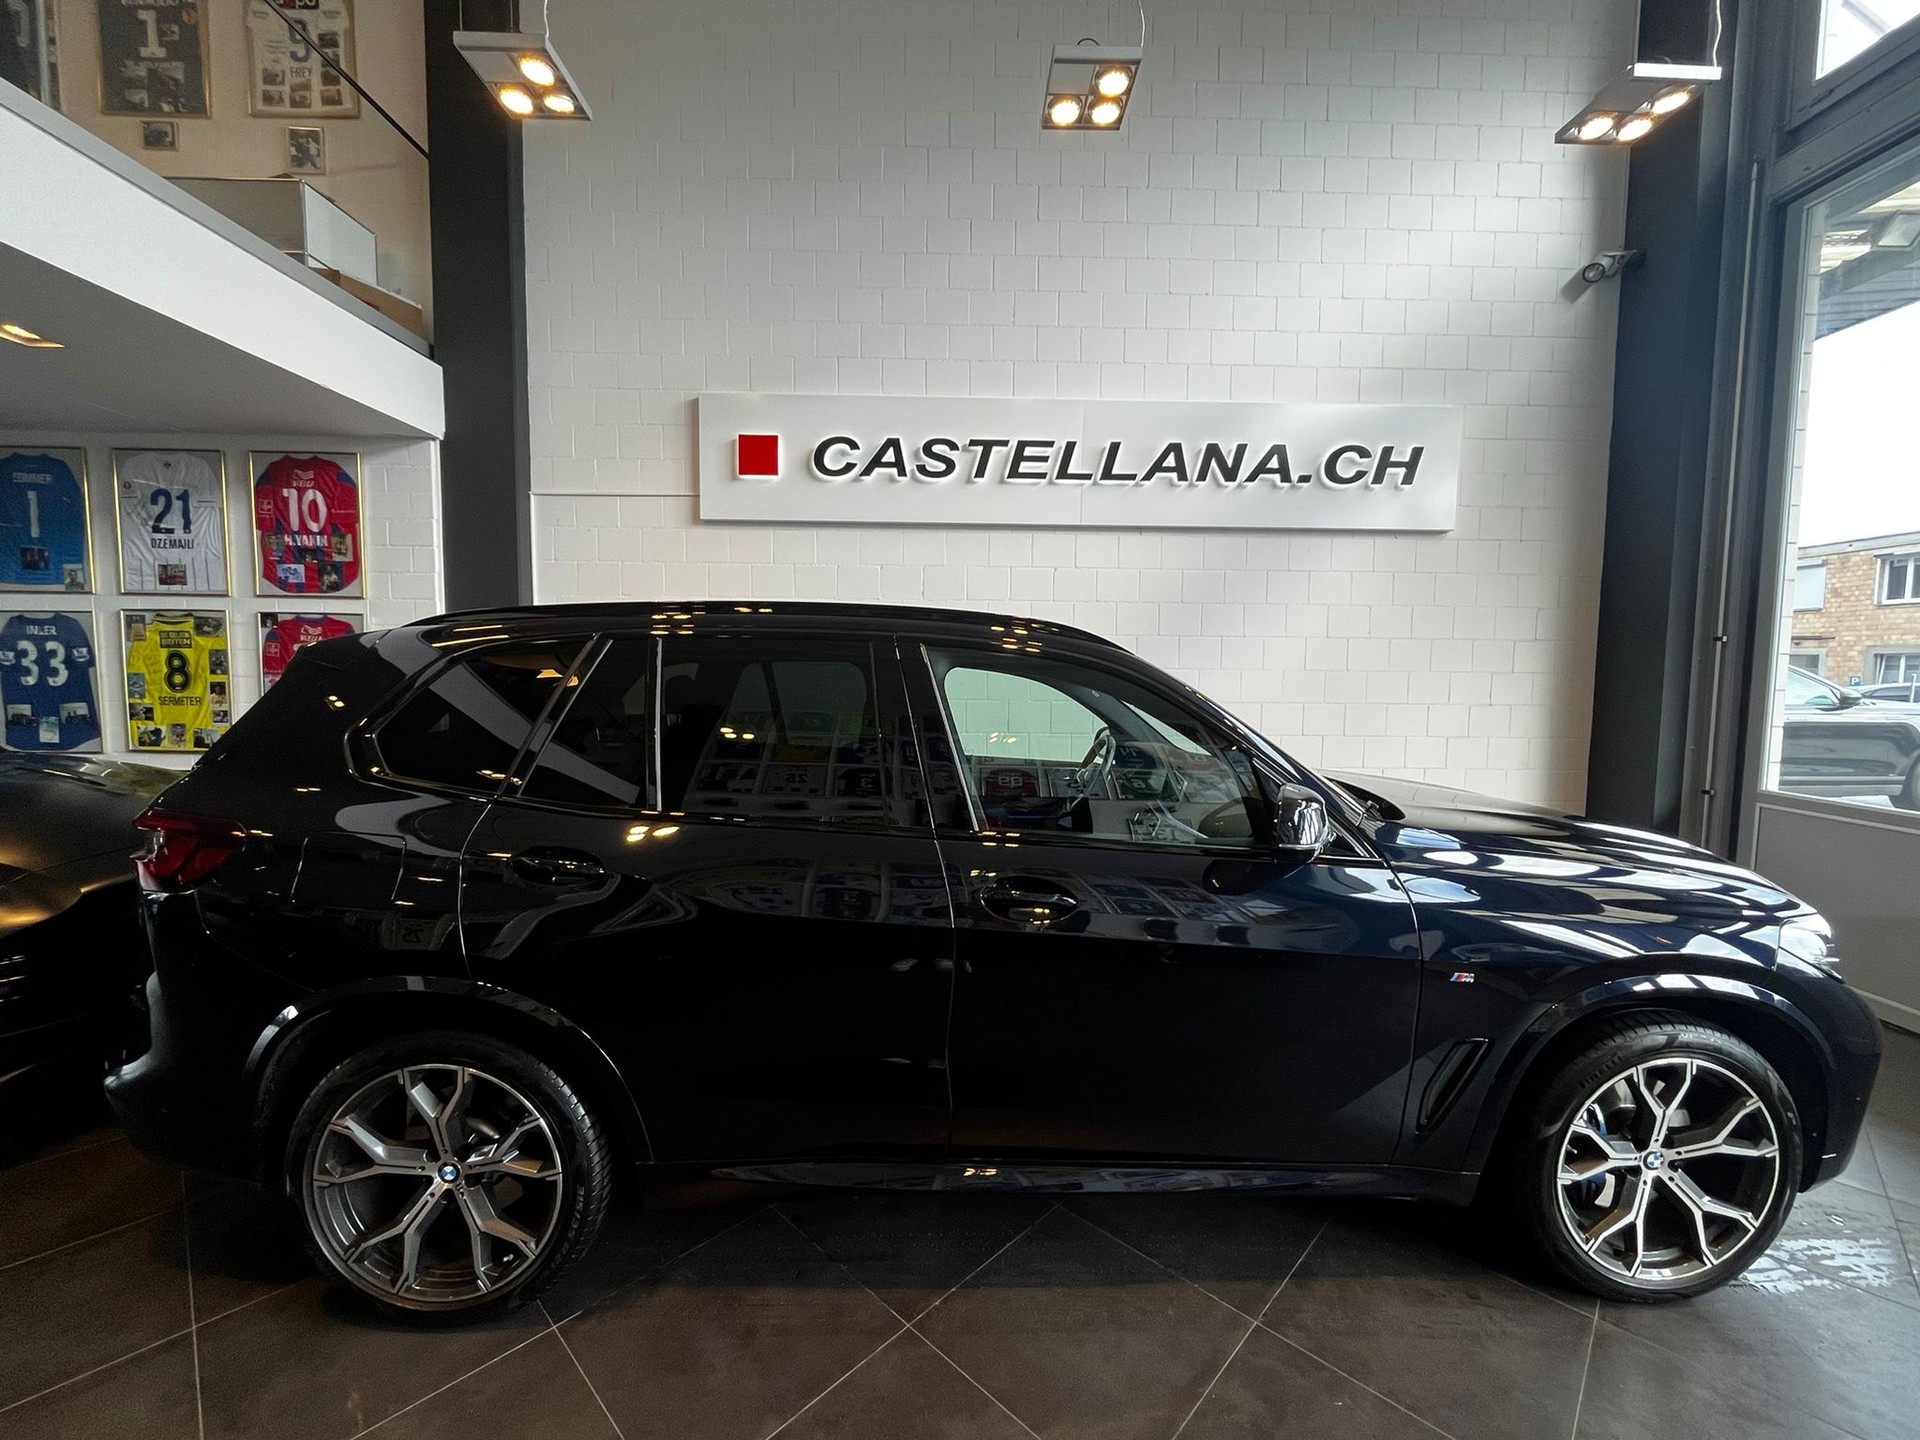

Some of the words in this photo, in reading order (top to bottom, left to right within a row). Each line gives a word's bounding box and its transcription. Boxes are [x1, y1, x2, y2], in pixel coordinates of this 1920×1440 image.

[137, 9, 168, 58] 1
[289, 65, 313, 79] FREY
[812, 435, 1425, 486] CASTELLANA.CH
[26, 490, 41, 538] 1
[150, 487, 192, 534] 21
[282, 488, 328, 533] 10
[17, 639, 69, 687] 33
[164, 649, 193, 694] 8
[157, 695, 203, 707] SERMETER
